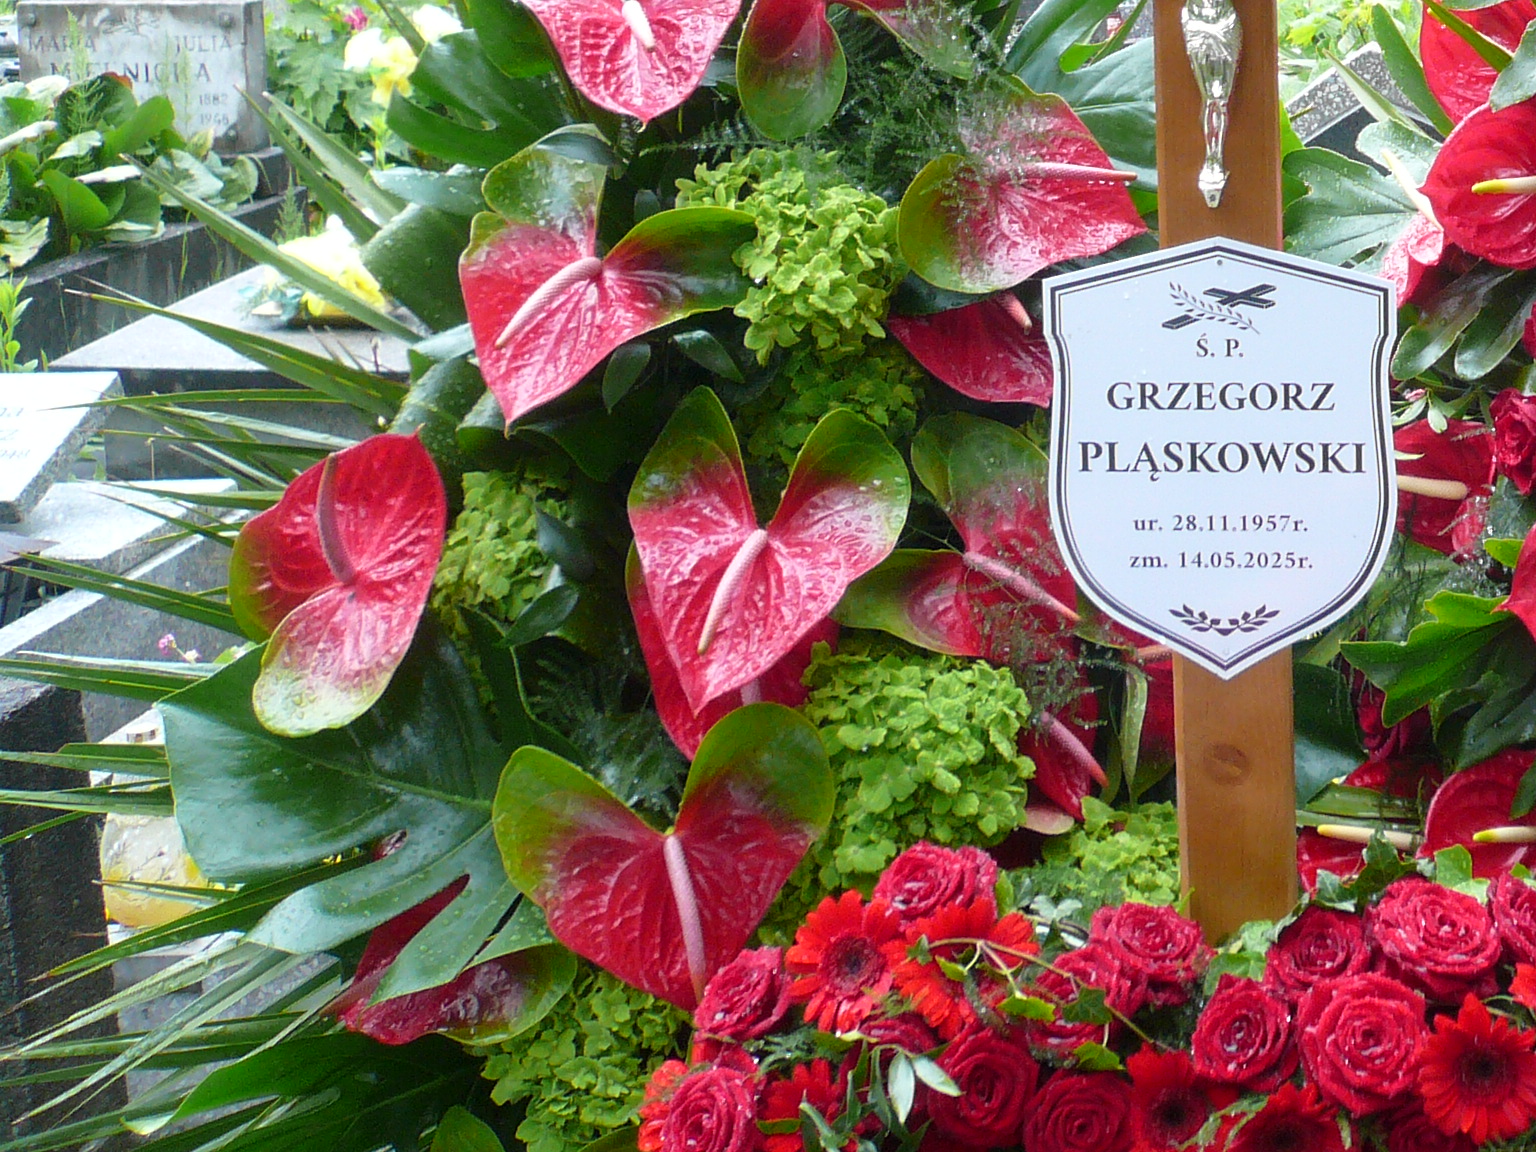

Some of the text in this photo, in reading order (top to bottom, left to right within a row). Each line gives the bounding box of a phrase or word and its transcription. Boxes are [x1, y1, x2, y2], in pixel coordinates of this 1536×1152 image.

[174, 35, 233, 54] JULIA
[1195, 333, 1244, 358] Ś. P.
[1106, 381, 1336, 412] GRZEGORZ
[1078, 440, 1367, 482] PLĄSKOWSKI
[1133, 514, 1309, 533] ur. 28.11.1957r.
[1129, 551, 1314, 570] zm. 14.05.2025r.
